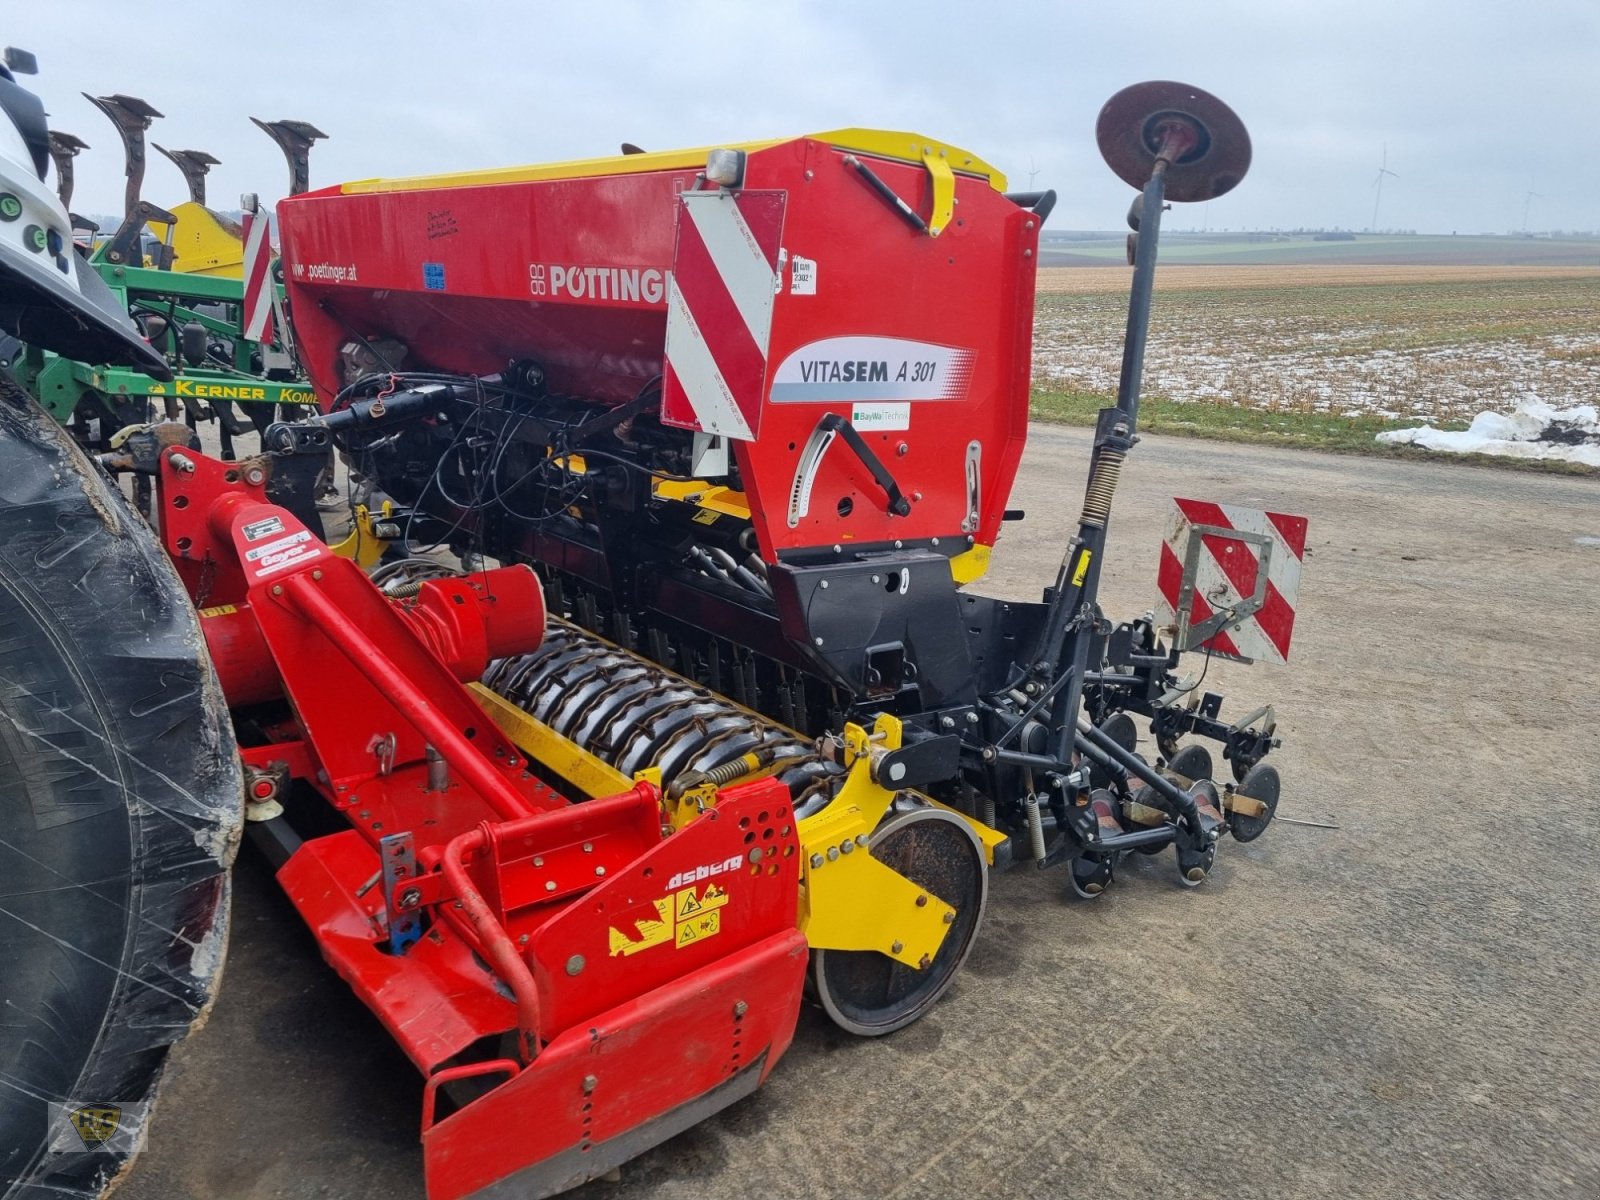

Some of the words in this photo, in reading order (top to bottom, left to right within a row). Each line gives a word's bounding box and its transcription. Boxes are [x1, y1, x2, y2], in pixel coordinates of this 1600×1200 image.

[549, 265, 674, 304] PÖTTING
[800, 360, 889, 383] VITASEM
[895, 360, 908, 382] A
[911, 361, 937, 383] 301
[175, 379, 265, 401] KERNER
[859, 412, 882, 421] BayWa
[884, 410, 909, 421] Technik
[665, 855, 743, 891] dsberg
